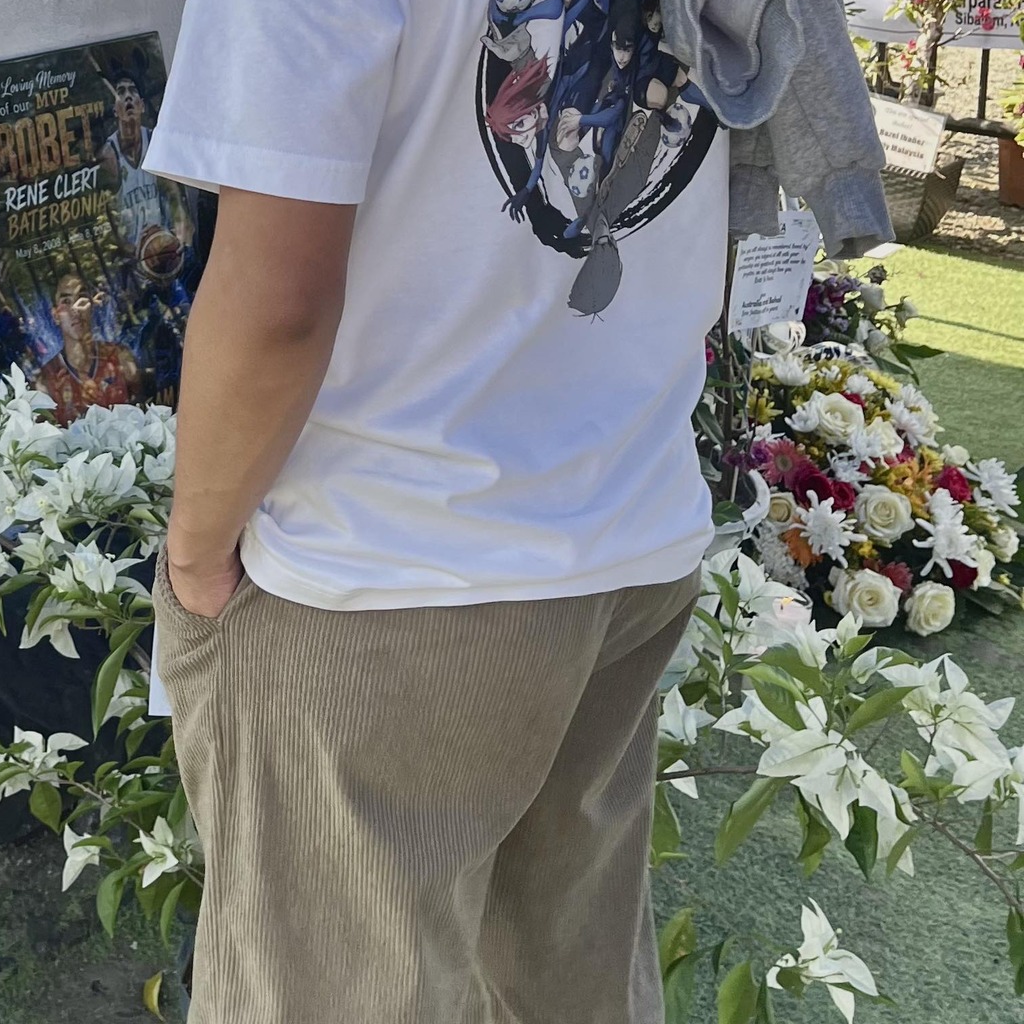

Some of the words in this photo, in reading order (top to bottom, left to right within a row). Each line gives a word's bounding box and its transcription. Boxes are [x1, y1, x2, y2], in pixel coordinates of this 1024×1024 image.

[0, 76, 34, 98] Loving
[36, 70, 76, 89] Memory
[0, 102, 10, 116] of
[13, 100, 30, 114] our
[35, 86, 69, 110] MVP
[4, 179, 49, 212] RENE
[54, 164, 100, 200] CLERT
[8, 190, 112, 241] BATERBONIA
[15, 246, 32, 260] May
[34, 244, 42, 254] 8,
